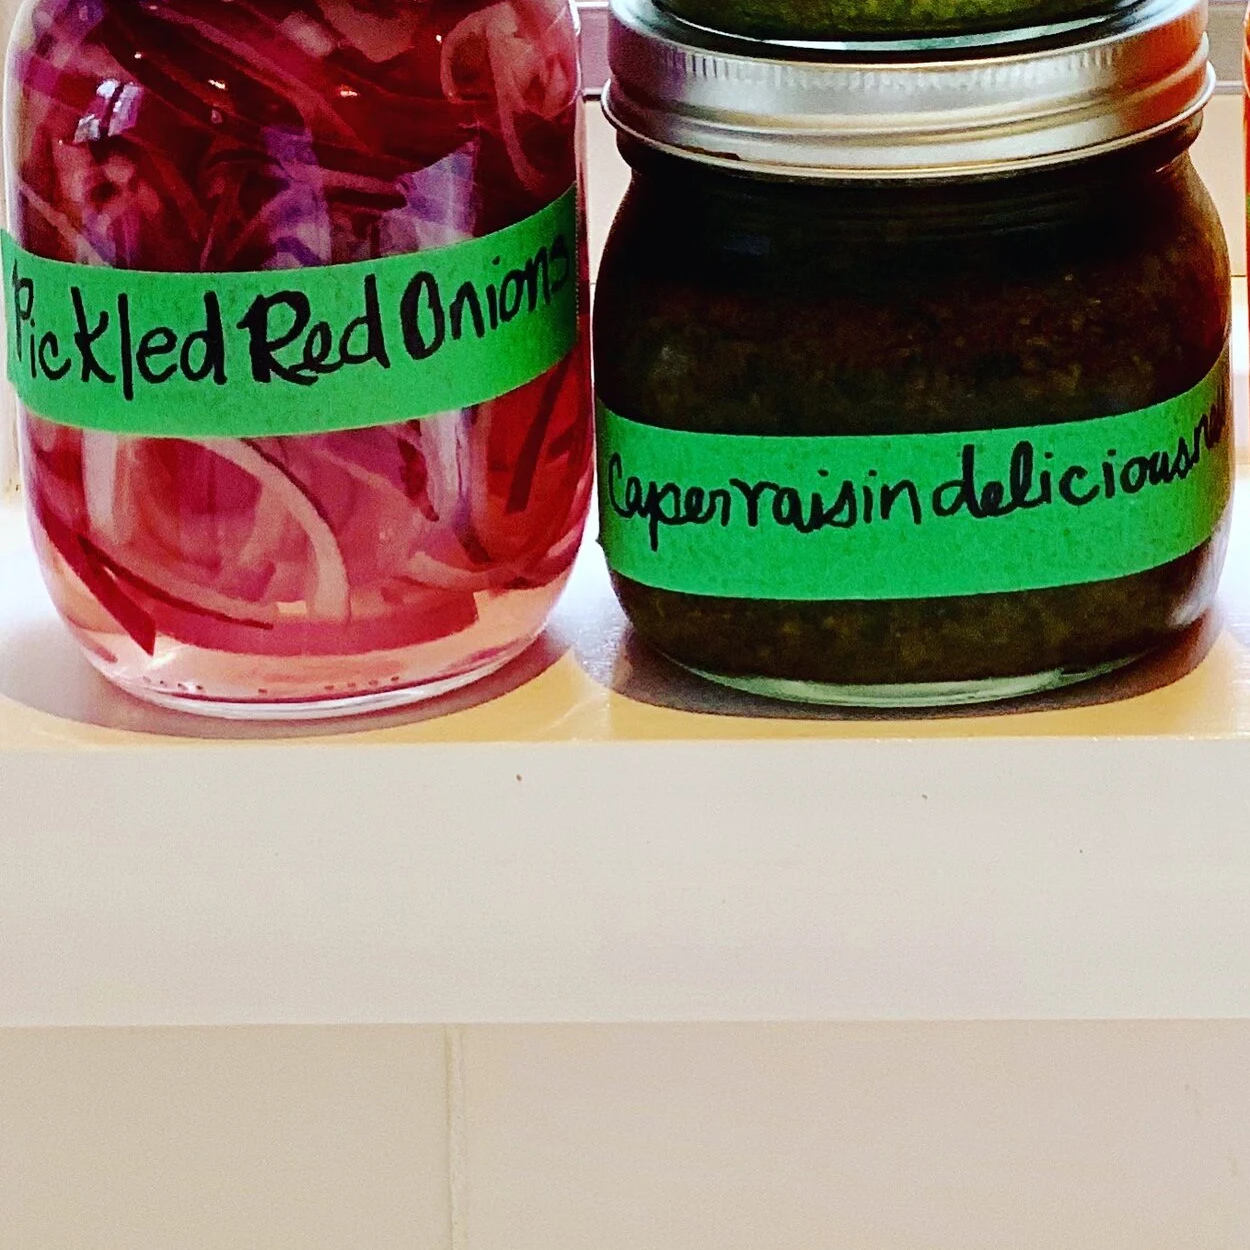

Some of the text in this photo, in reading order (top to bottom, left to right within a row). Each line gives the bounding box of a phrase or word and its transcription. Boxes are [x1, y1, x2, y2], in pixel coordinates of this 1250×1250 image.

[12, 234, 570, 401] Pickled Red Onions
